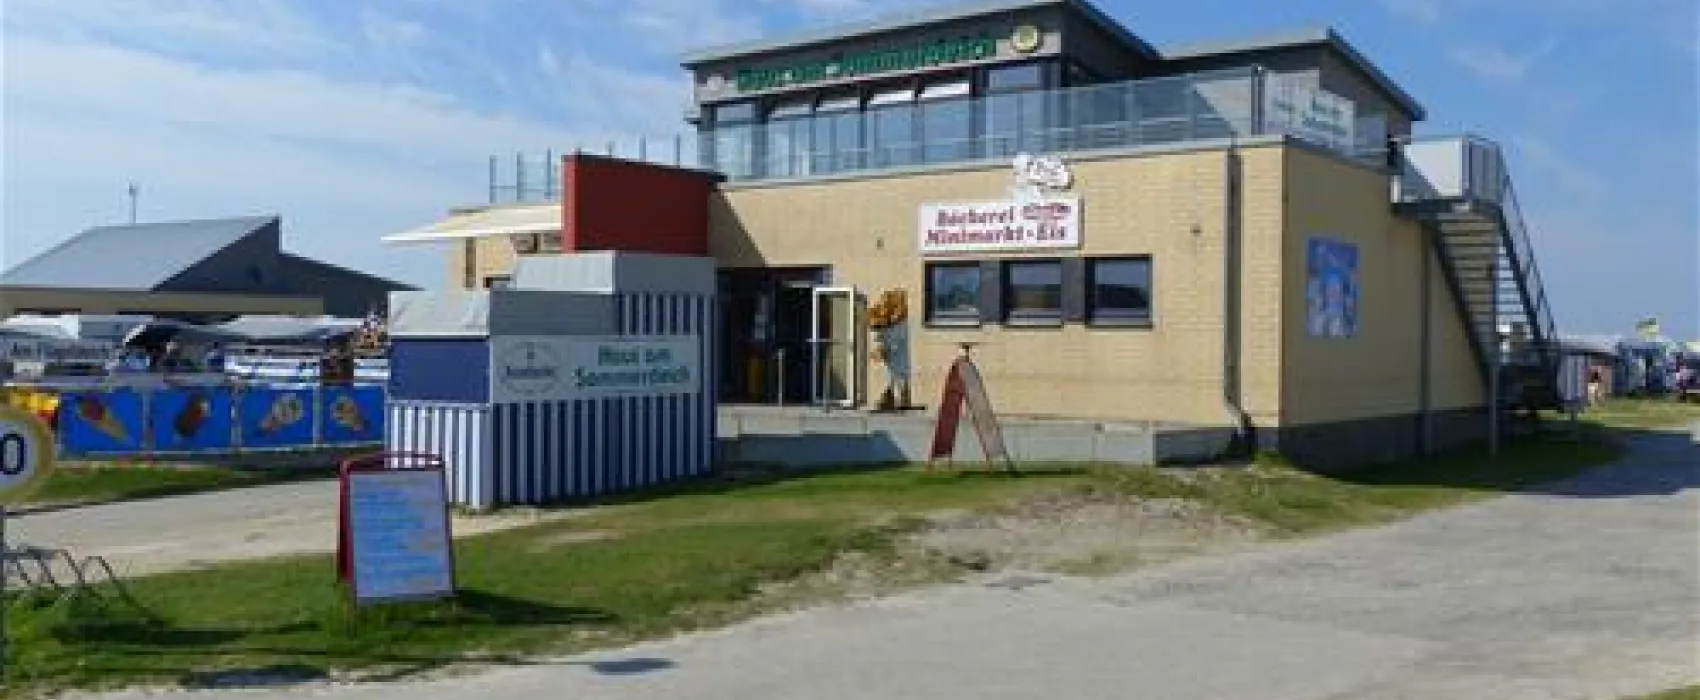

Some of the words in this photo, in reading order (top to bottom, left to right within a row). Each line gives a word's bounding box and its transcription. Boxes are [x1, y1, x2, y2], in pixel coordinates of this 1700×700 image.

[937, 206, 1014, 226] Bäckerei
[925, 225, 1024, 246] Minimarkt
[1036, 222, 1066, 240] Eis
